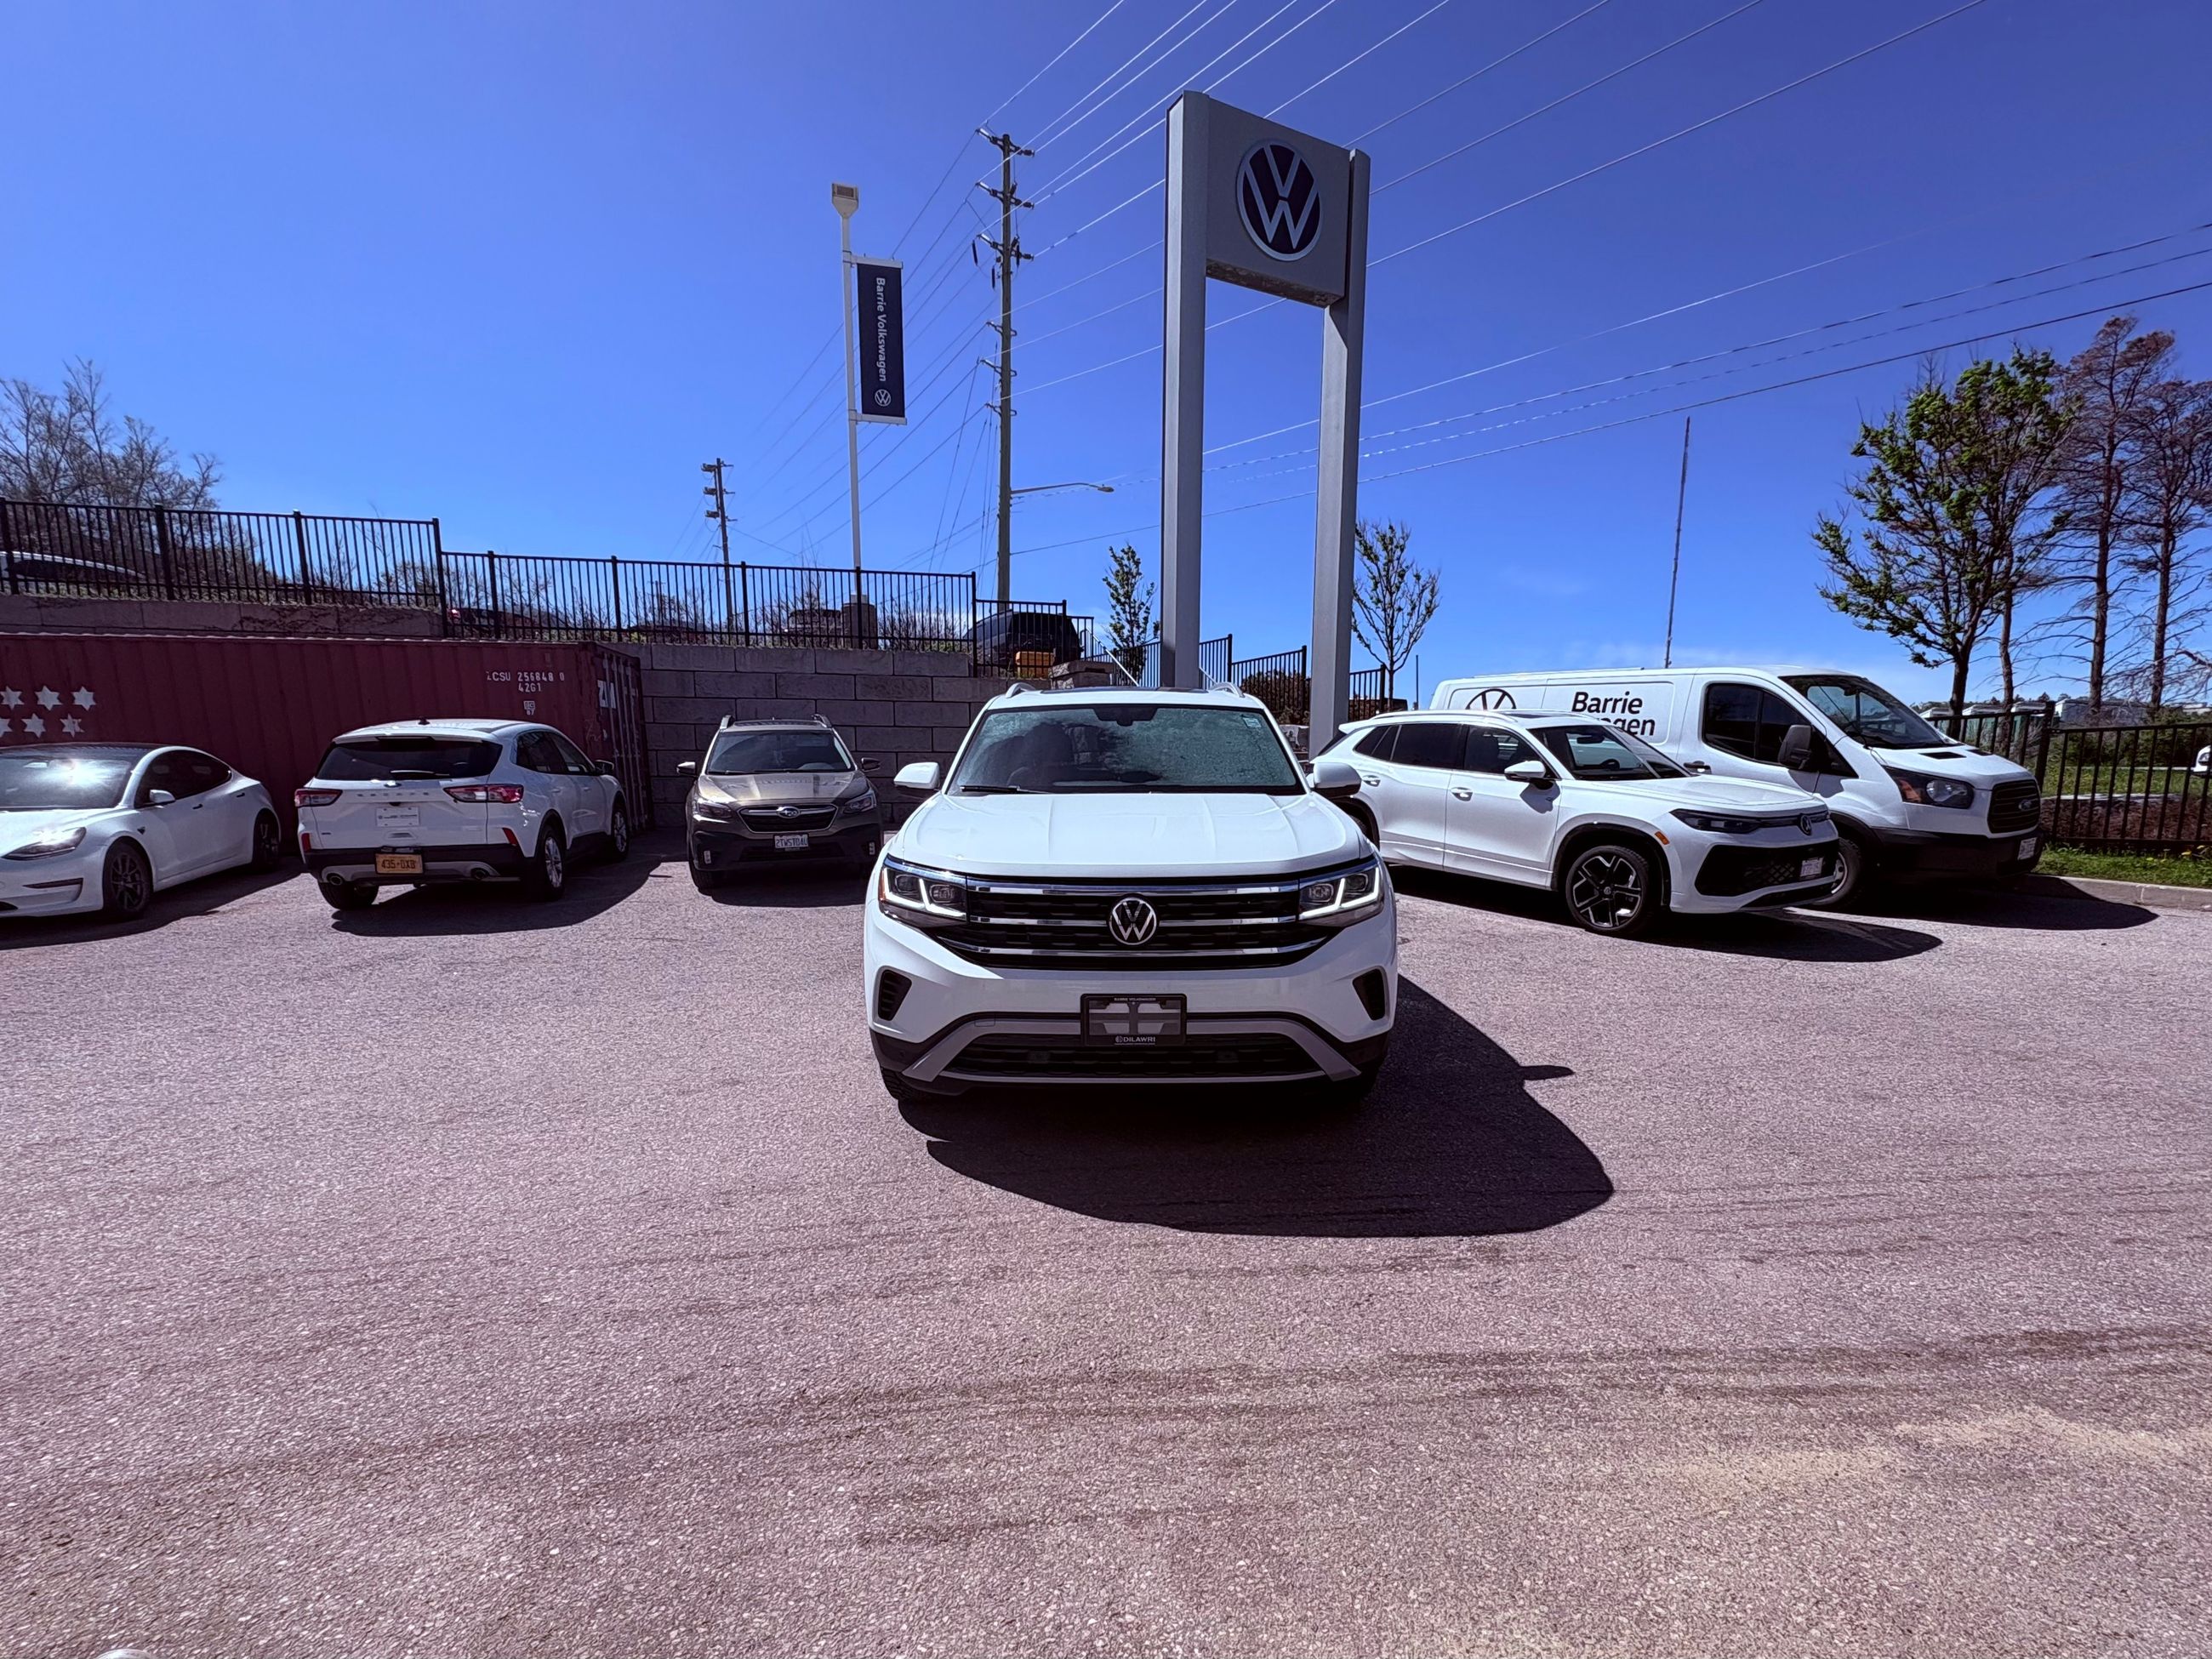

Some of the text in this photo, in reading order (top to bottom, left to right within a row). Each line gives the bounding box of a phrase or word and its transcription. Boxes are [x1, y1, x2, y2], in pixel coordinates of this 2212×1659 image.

[875, 276, 887, 382] Barrie Volkswagen
[517, 671, 554, 681] 256848
[518, 682, 542, 693] 42G1
[1571, 691, 1643, 715] Barrie
